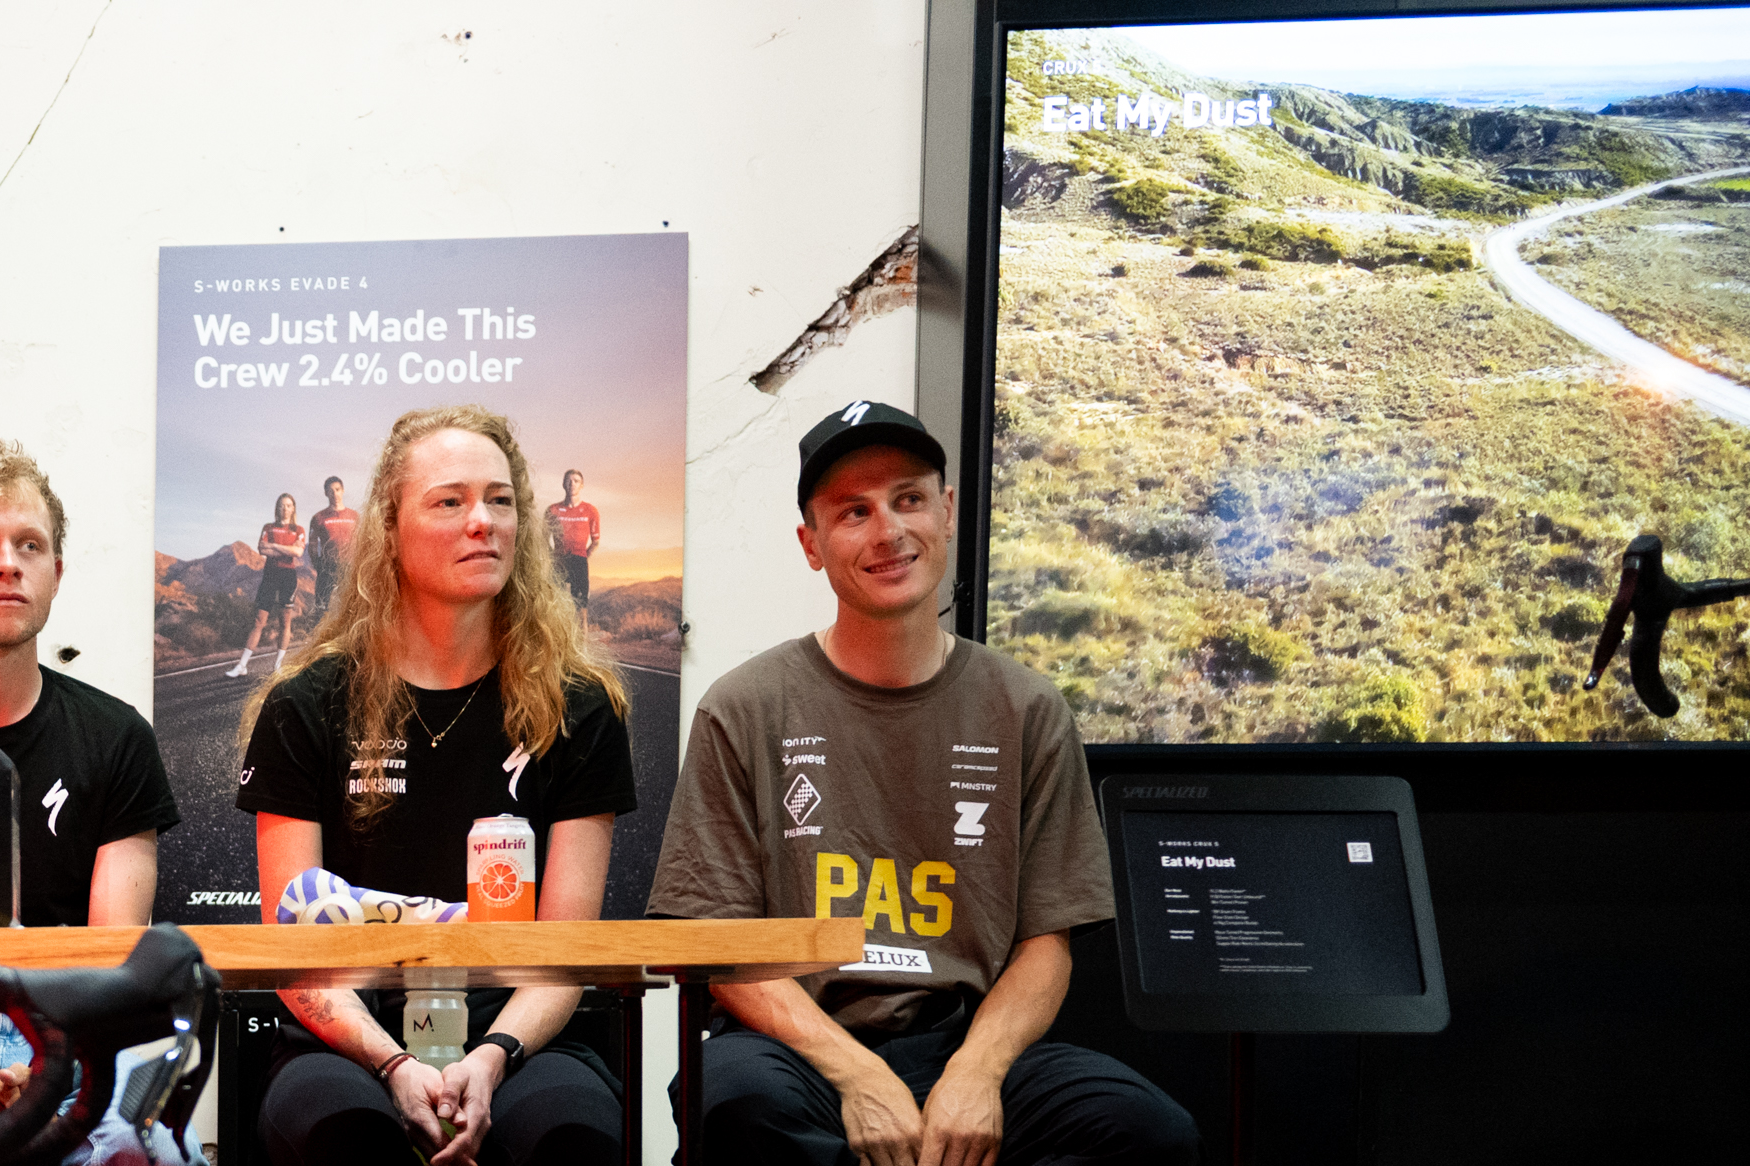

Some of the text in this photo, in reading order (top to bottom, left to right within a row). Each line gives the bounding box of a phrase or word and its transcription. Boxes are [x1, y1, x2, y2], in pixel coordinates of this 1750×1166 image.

[1042, 60, 1088, 75] CRUX
[1043, 92, 1274, 137] Eat My Dust
[194, 276, 368, 293] S-WORKS EVADE 4
[193, 306, 537, 347] We Just Made This
[194, 350, 524, 388] Crew 2.4% Cooler
[952, 744, 999, 754] SALOMON
[792, 754, 826, 765] sweet
[473, 838, 527, 854] spindrift
[954, 837, 984, 846] ZWIFT
[1161, 856, 1236, 870] Eat My Dust
[815, 852, 956, 937] PAS
[863, 950, 922, 967] ELUX
